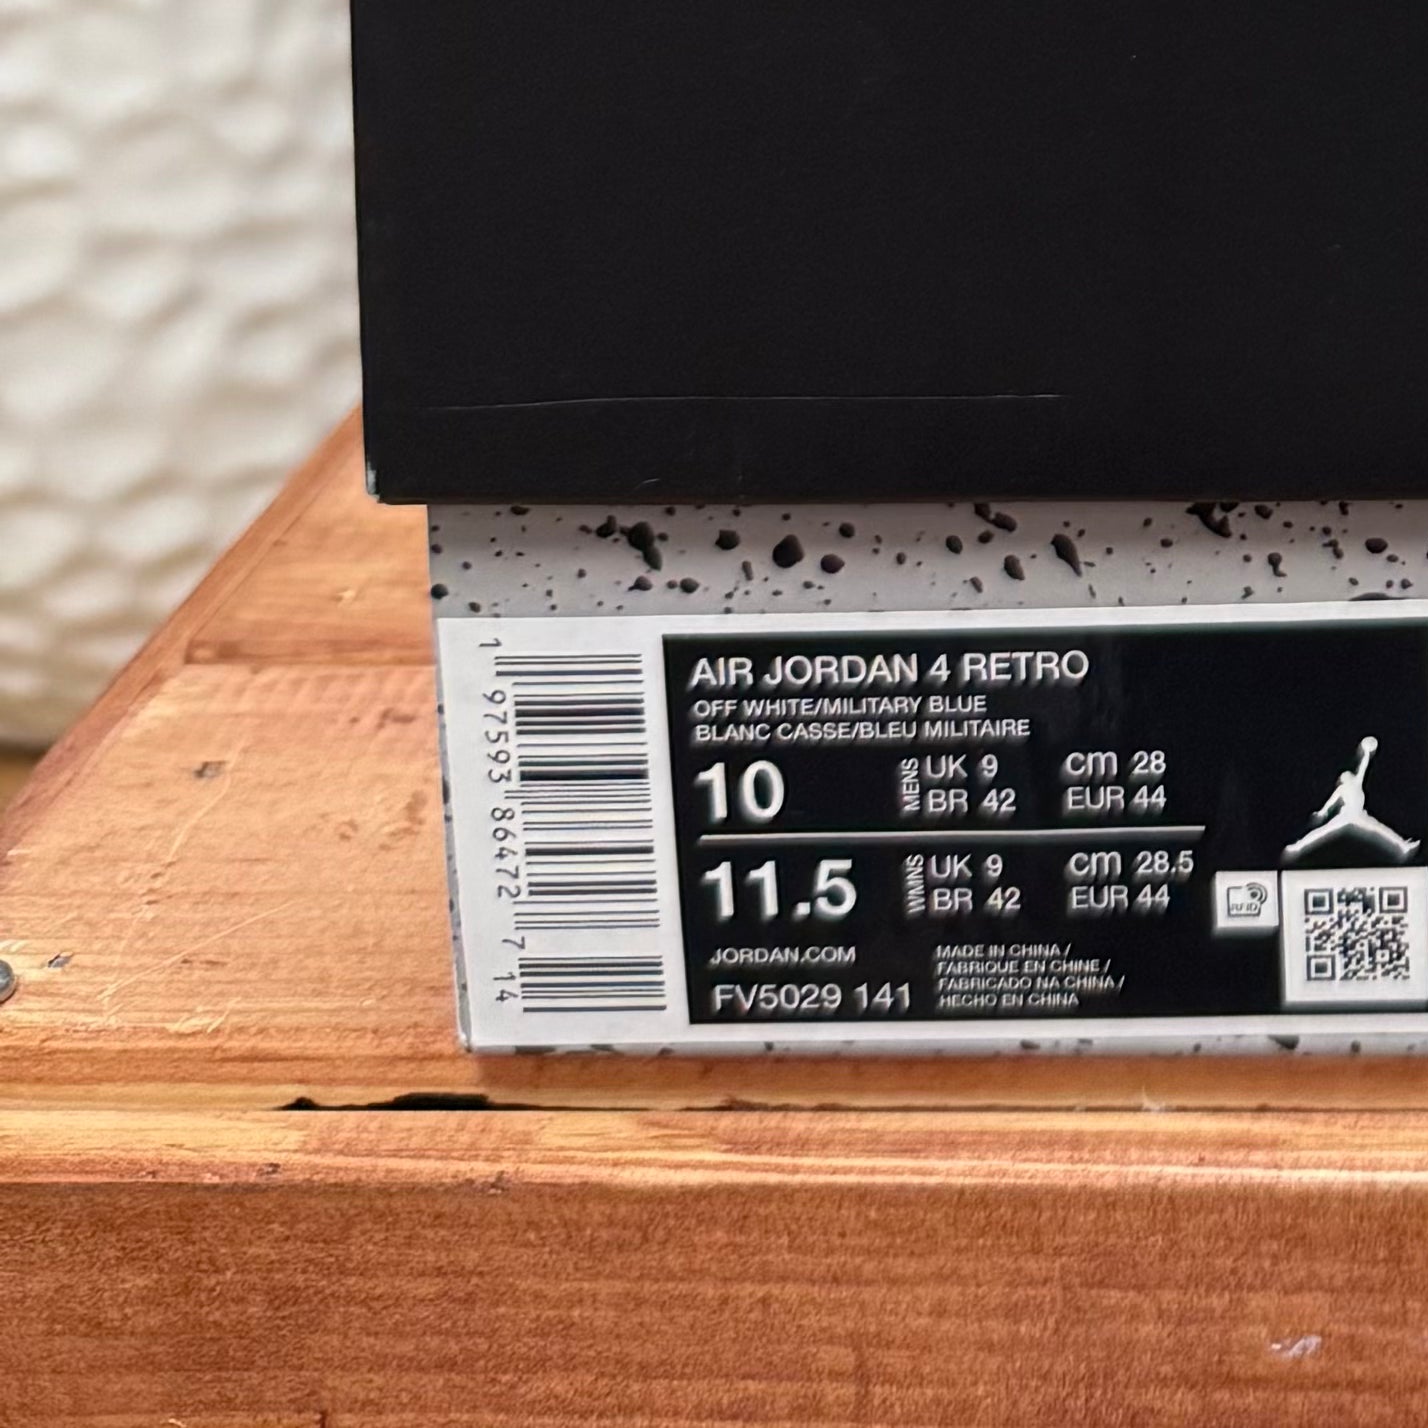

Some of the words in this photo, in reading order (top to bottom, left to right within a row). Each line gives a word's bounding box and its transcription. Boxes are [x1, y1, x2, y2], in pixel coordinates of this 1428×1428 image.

[689, 656, 753, 687] AIR
[764, 653, 919, 686] JORDAN
[929, 652, 951, 683] 4
[962, 650, 1090, 683] RETRO
[692, 699, 737, 719] OFF
[743, 695, 922, 717] WHITE/MILITARY
[929, 694, 988, 713] BLUE
[482, 689, 513, 784] 97593
[693, 723, 771, 743] BLANC
[777, 720, 917, 741] CASSE/BLEU
[924, 718, 1032, 738] MILITAIRE
[925, 754, 968, 779] UK
[980, 753, 999, 778] 9
[1064, 750, 1119, 776] cm
[1131, 750, 1167, 775] 28
[694, 760, 786, 823] 10
[902, 756, 920, 812] MENS
[928, 788, 969, 813] BR
[982, 787, 1017, 813] 42
[1065, 786, 1125, 810] EUR
[1131, 785, 1167, 809] 44
[490, 807, 522, 899] 86472
[930, 853, 973, 879] UK
[985, 853, 1003, 877] 9
[1069, 850, 1122, 876] cm
[1134, 849, 1195, 874] 28.5
[703, 859, 857, 918] 11.5
[905, 853, 925, 915] WMNS
[933, 887, 973, 912] BR
[986, 886, 1021, 911] 42
[1071, 885, 1129, 910] EUR
[1135, 883, 1170, 908] 44
[709, 945, 857, 965] JORDAN.COM
[935, 944, 985, 959] MADE
[989, 943, 1005, 957] IN
[1008, 943, 1061, 958] CHINA
[1024, 959, 1046, 973] EN
[1050, 958, 1101, 973] CHINE
[713, 982, 842, 1014] FV5029
[853, 981, 911, 1011] 141
[937, 976, 1032, 992] FABRICADO
[1036, 976, 1060, 990] NA
[1064, 975, 1116, 990] CHINA
[938, 993, 998, 1008] HECHO
[1002, 993, 1024, 1007] EN
[1028, 992, 1080, 1007] CHINA
